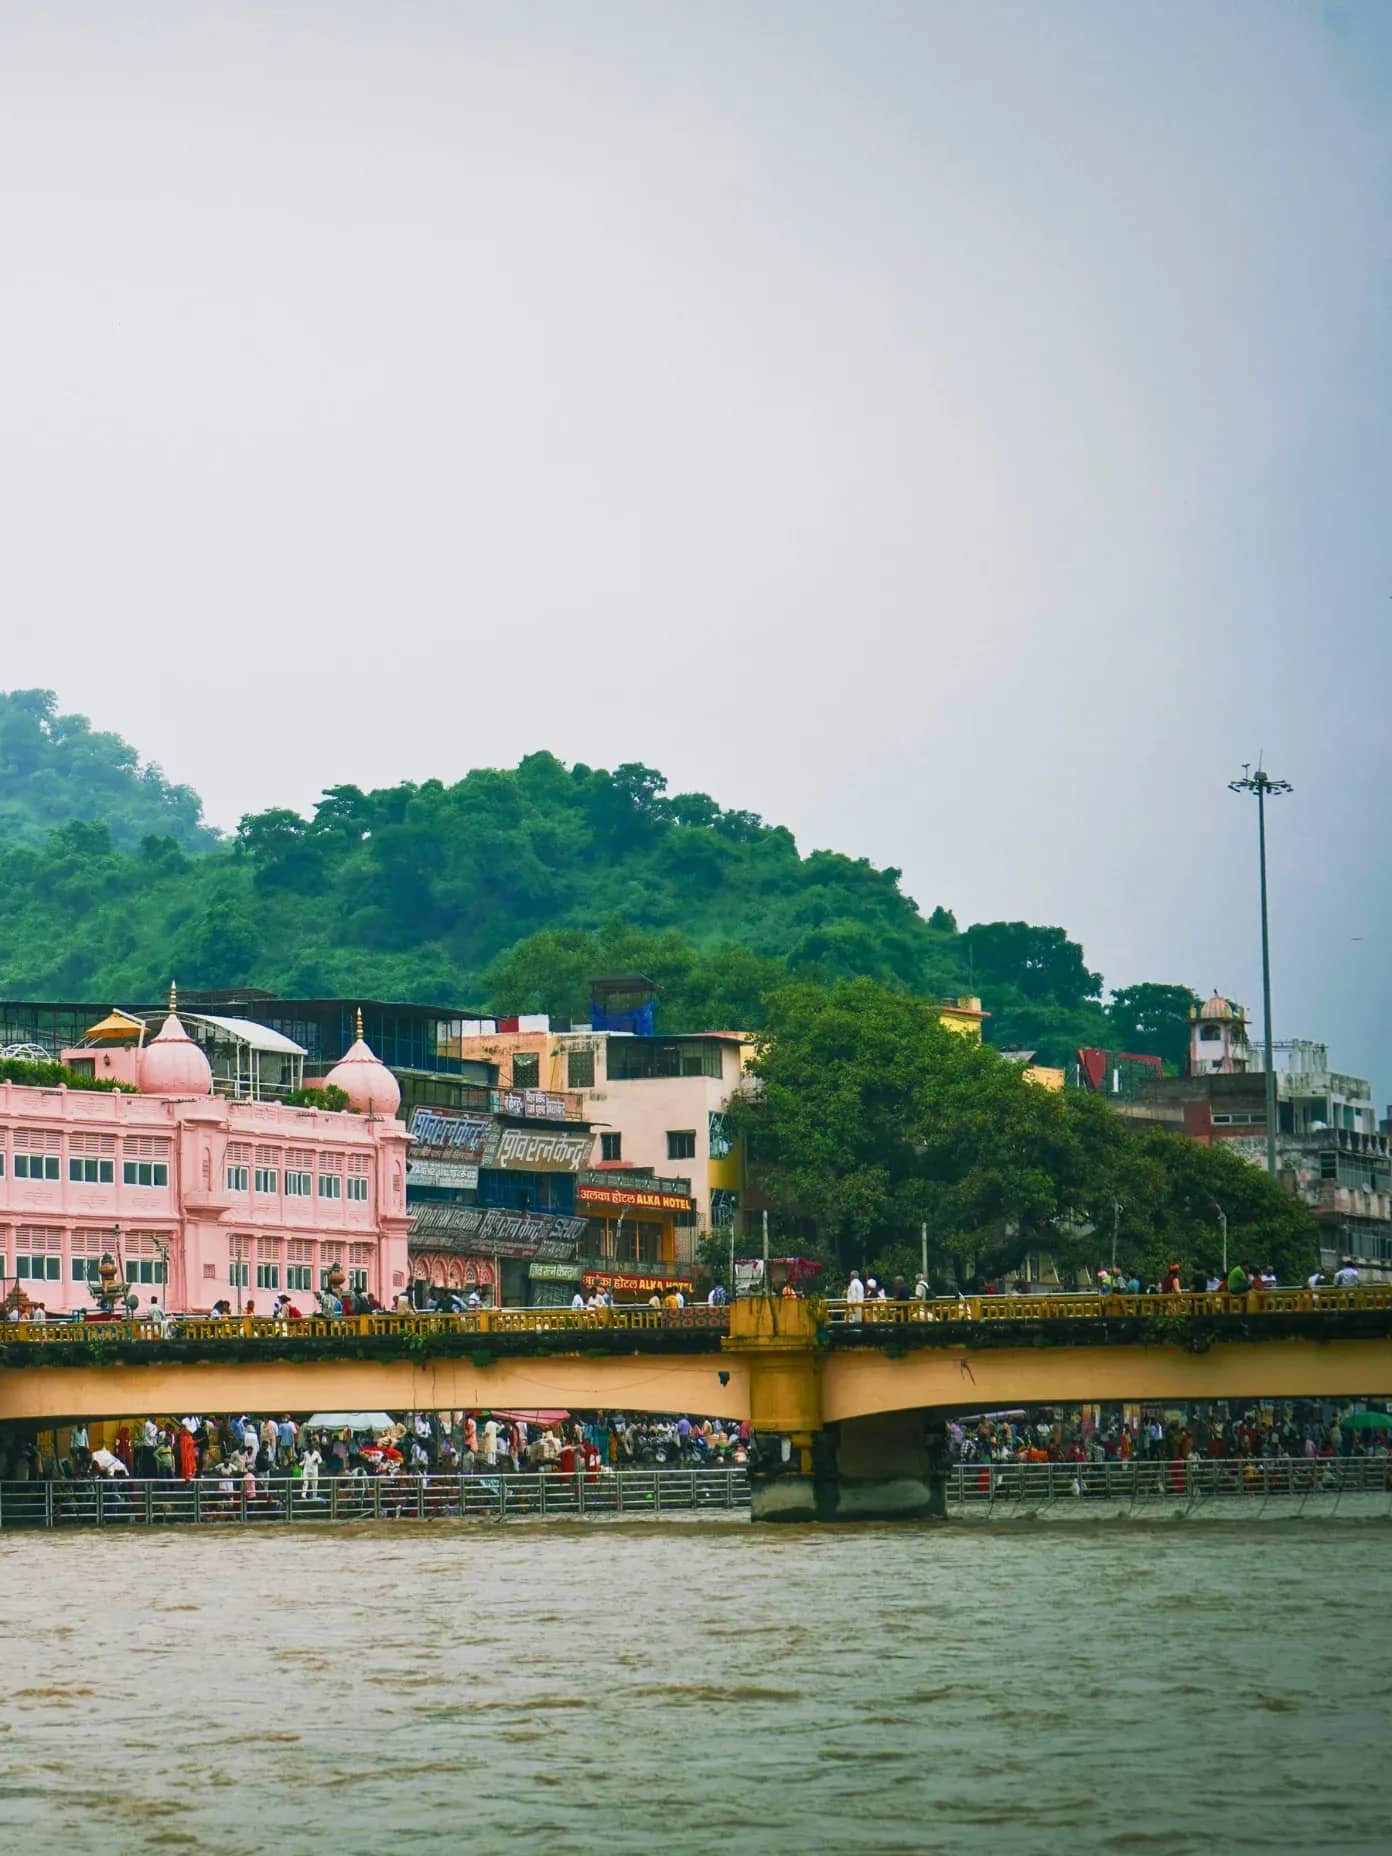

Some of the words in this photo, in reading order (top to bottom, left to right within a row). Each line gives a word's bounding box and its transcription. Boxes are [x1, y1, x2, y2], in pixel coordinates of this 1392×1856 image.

[496, 1130, 529, 1167] शिव
[525, 1136, 558, 1162] रत्न
[553, 1132, 587, 1170] केन्द्र
[581, 1190, 609, 1202] अलका
[612, 1190, 635, 1204] होटल
[636, 1194, 661, 1206] ALKA
[663, 1197, 691, 1210] HOTEL
[583, 1275, 611, 1287] अका
[614, 1276, 637, 1290] होटल
